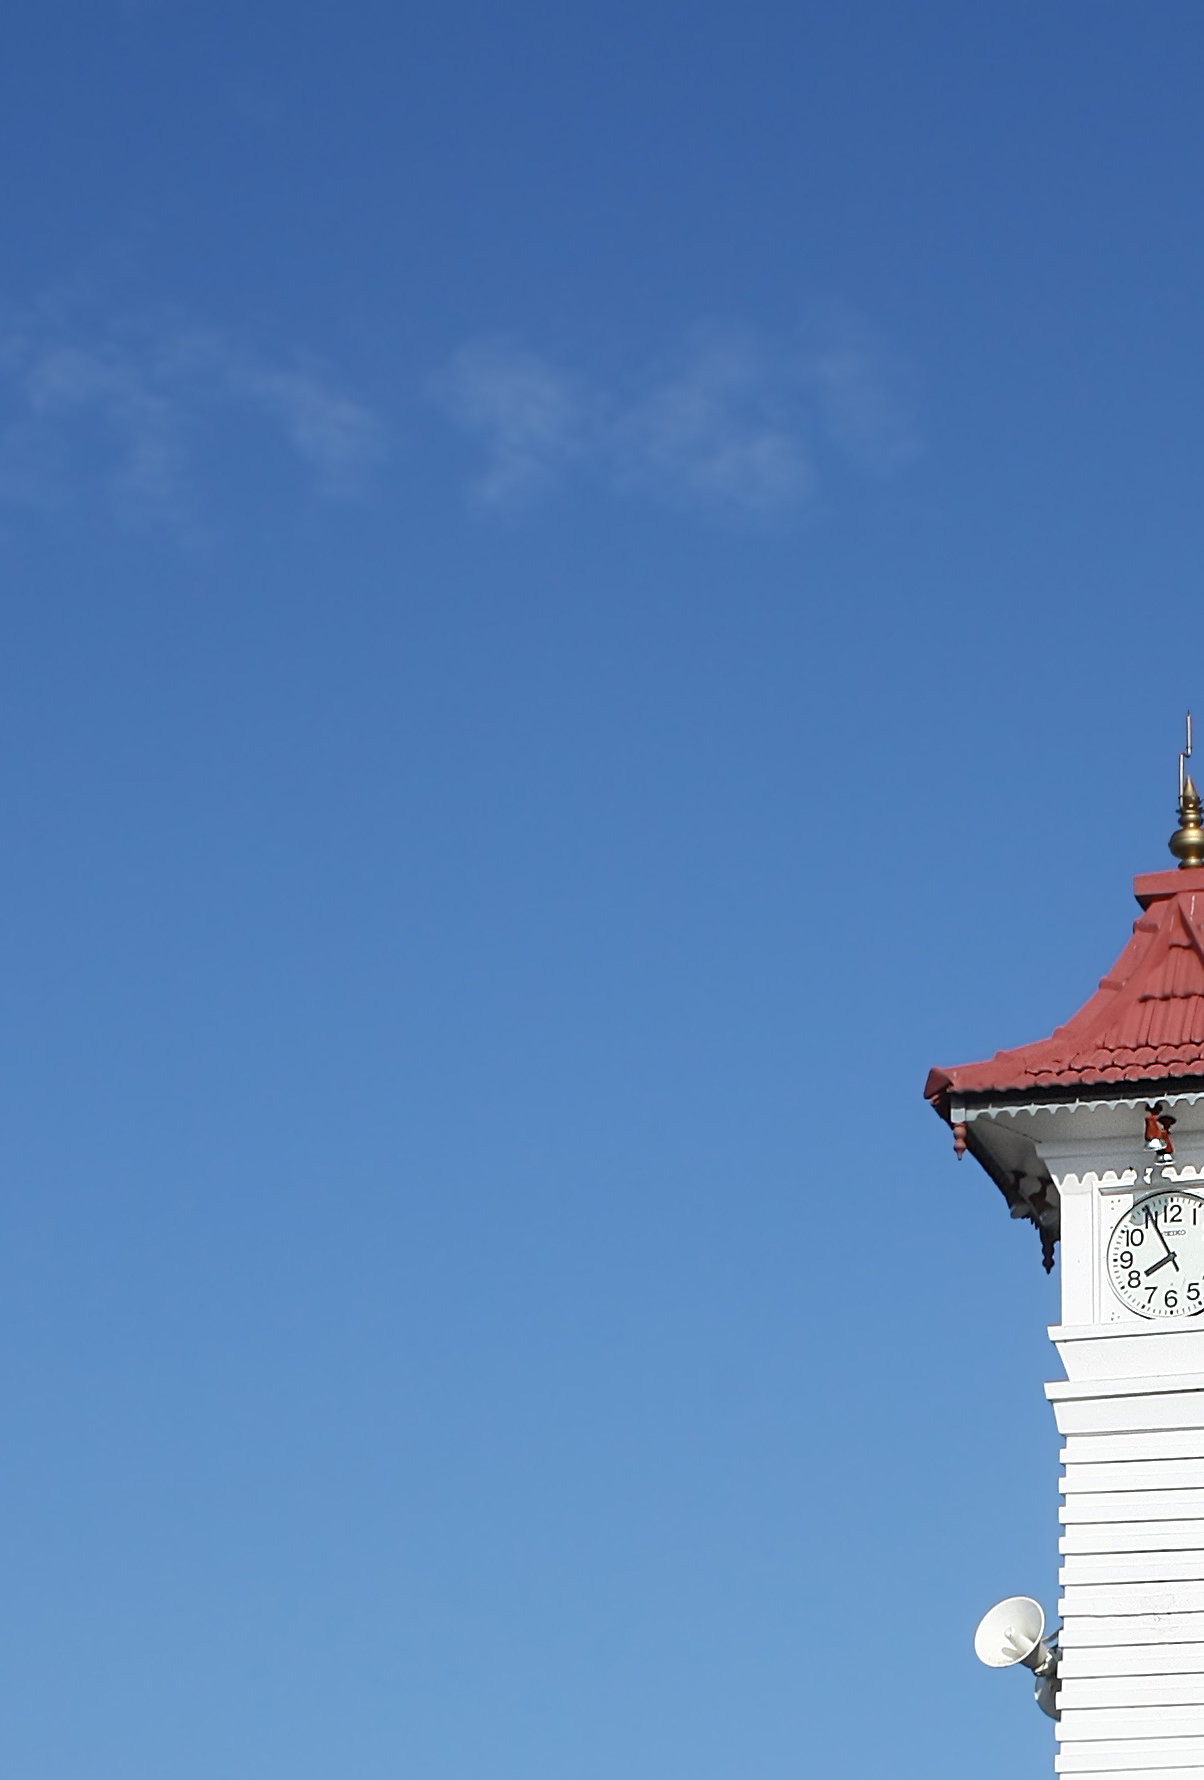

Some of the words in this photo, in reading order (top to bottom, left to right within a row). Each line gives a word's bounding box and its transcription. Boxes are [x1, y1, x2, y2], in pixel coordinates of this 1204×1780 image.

[1164, 1204, 1182, 1223] 12
[1193, 1208, 1197, 1226] 1
[1126, 1228, 1144, 1247] 10
[1120, 1251, 1133, 1269] 9
[1127, 1270, 1141, 1288] 8
[1144, 1286, 1158, 1304] 7
[1164, 1290, 1178, 1308] 6
[1186, 1283, 1200, 1301] 5
